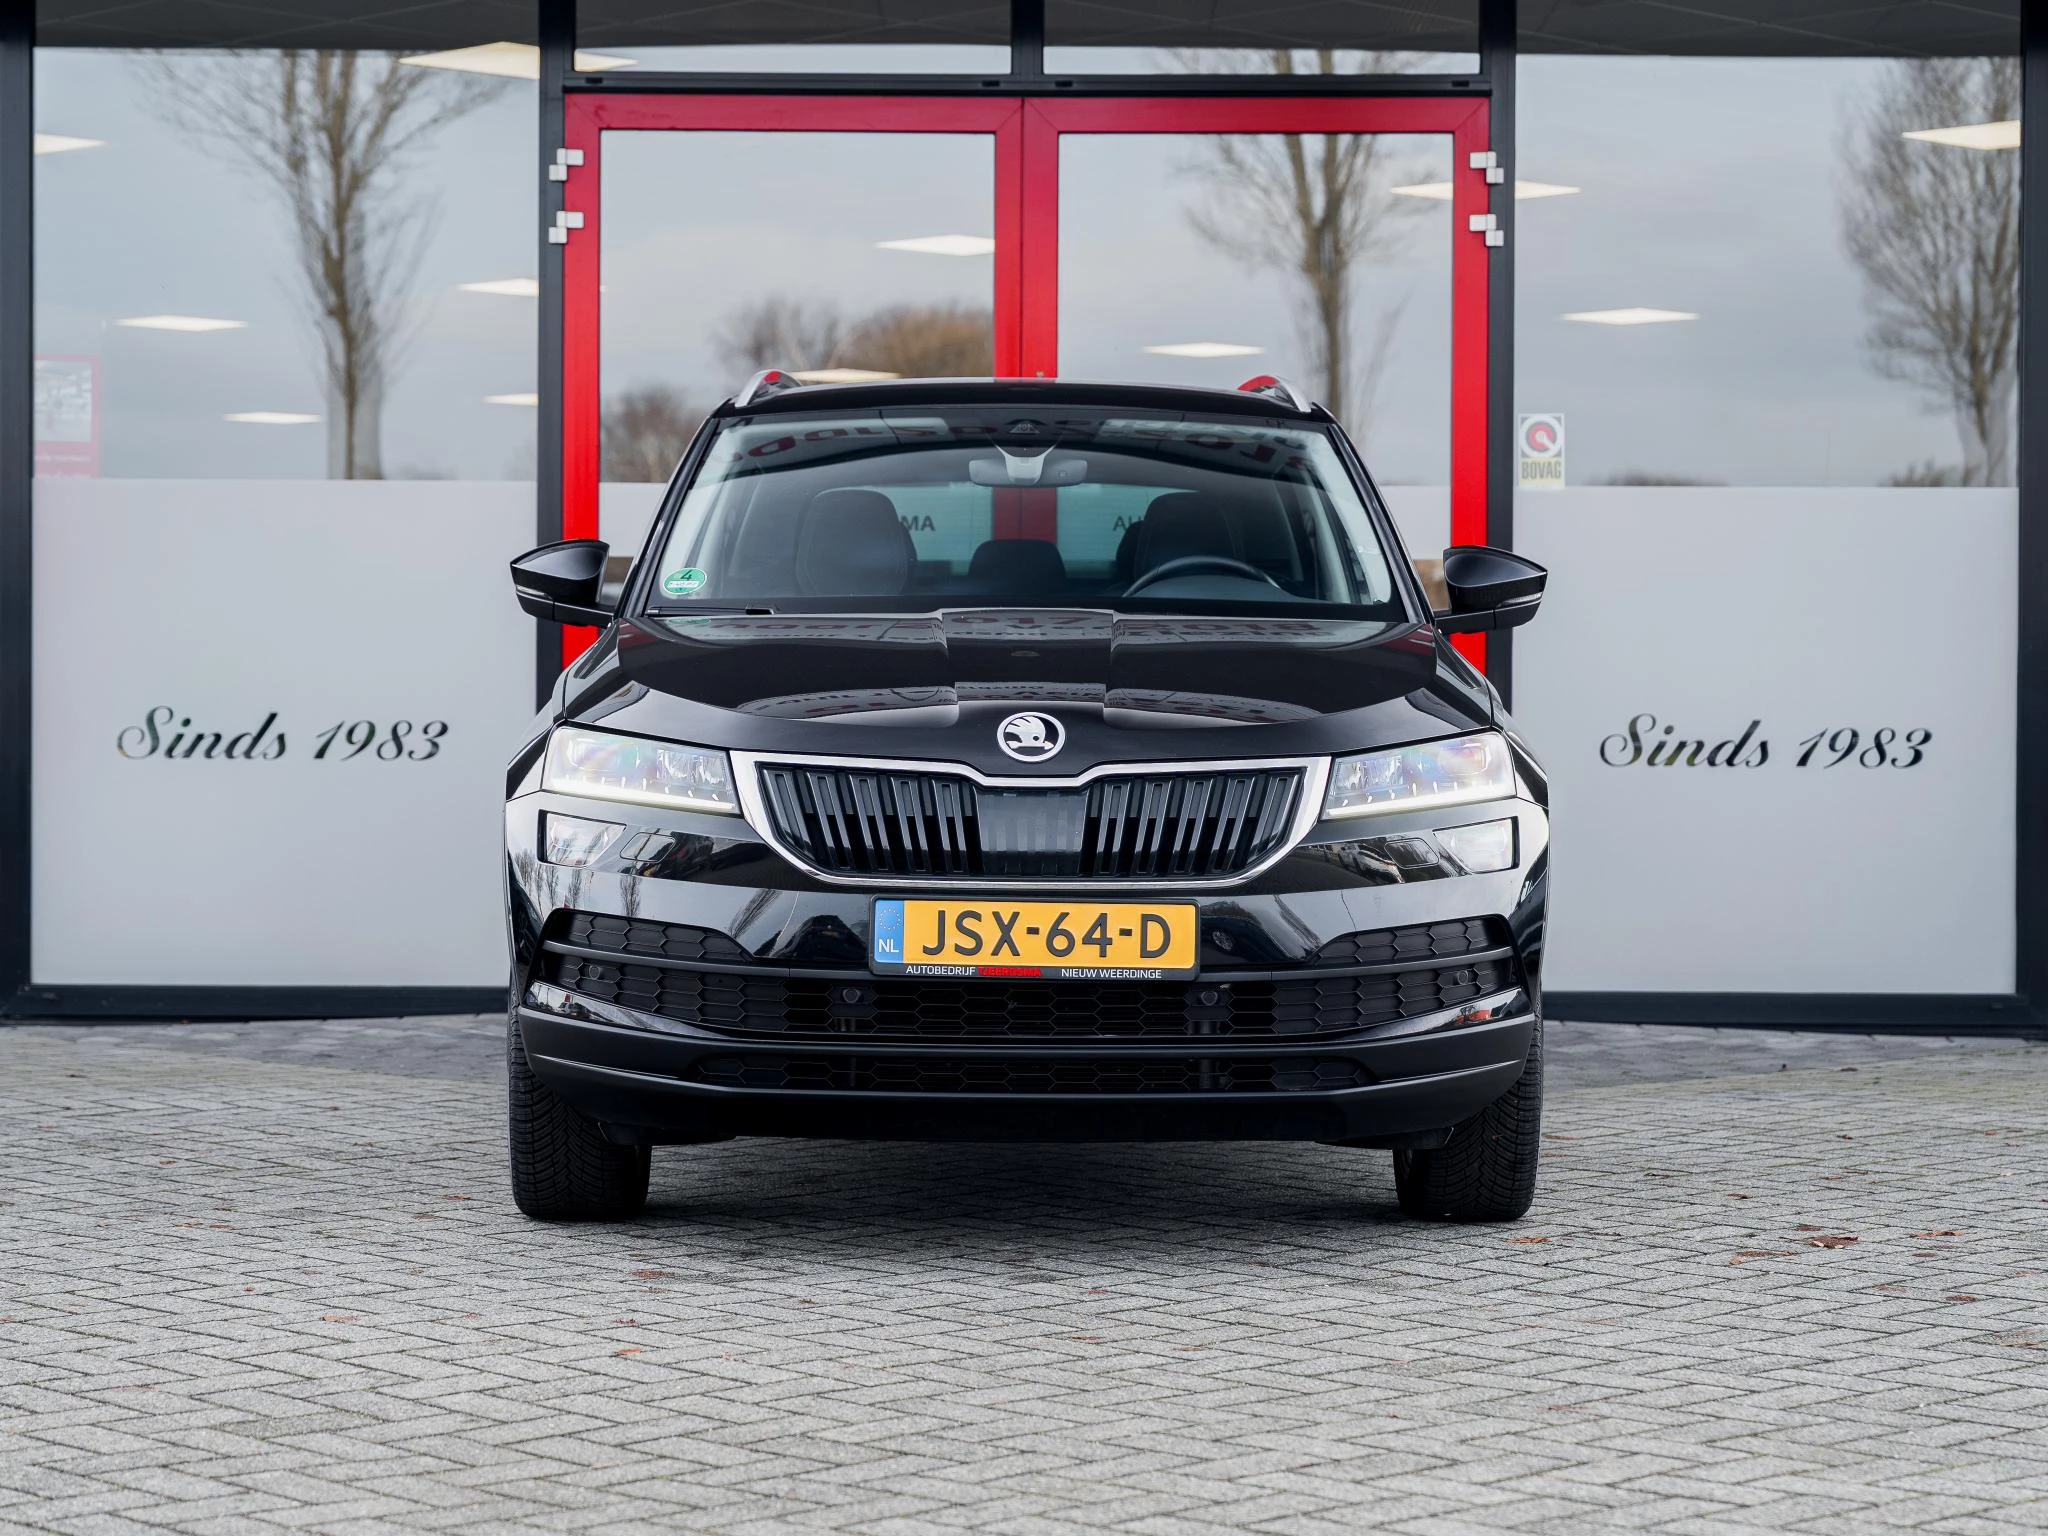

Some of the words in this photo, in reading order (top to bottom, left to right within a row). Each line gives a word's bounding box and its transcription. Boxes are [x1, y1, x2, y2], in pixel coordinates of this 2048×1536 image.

[1521, 461, 1561, 480] BOVAG
[116, 705, 287, 760] Sinds
[312, 719, 449, 762] 1983
[1599, 712, 1769, 768] Sinds
[1796, 727, 1933, 769] 1983
[878, 939, 900, 953] NL
[922, 909, 1172, 959] JSX-64-D
[905, 965, 976, 976] AUTOBEDRIJF
[1061, 968, 1098, 978] NIEUW
[1099, 968, 1162, 979] WEERDINGE
